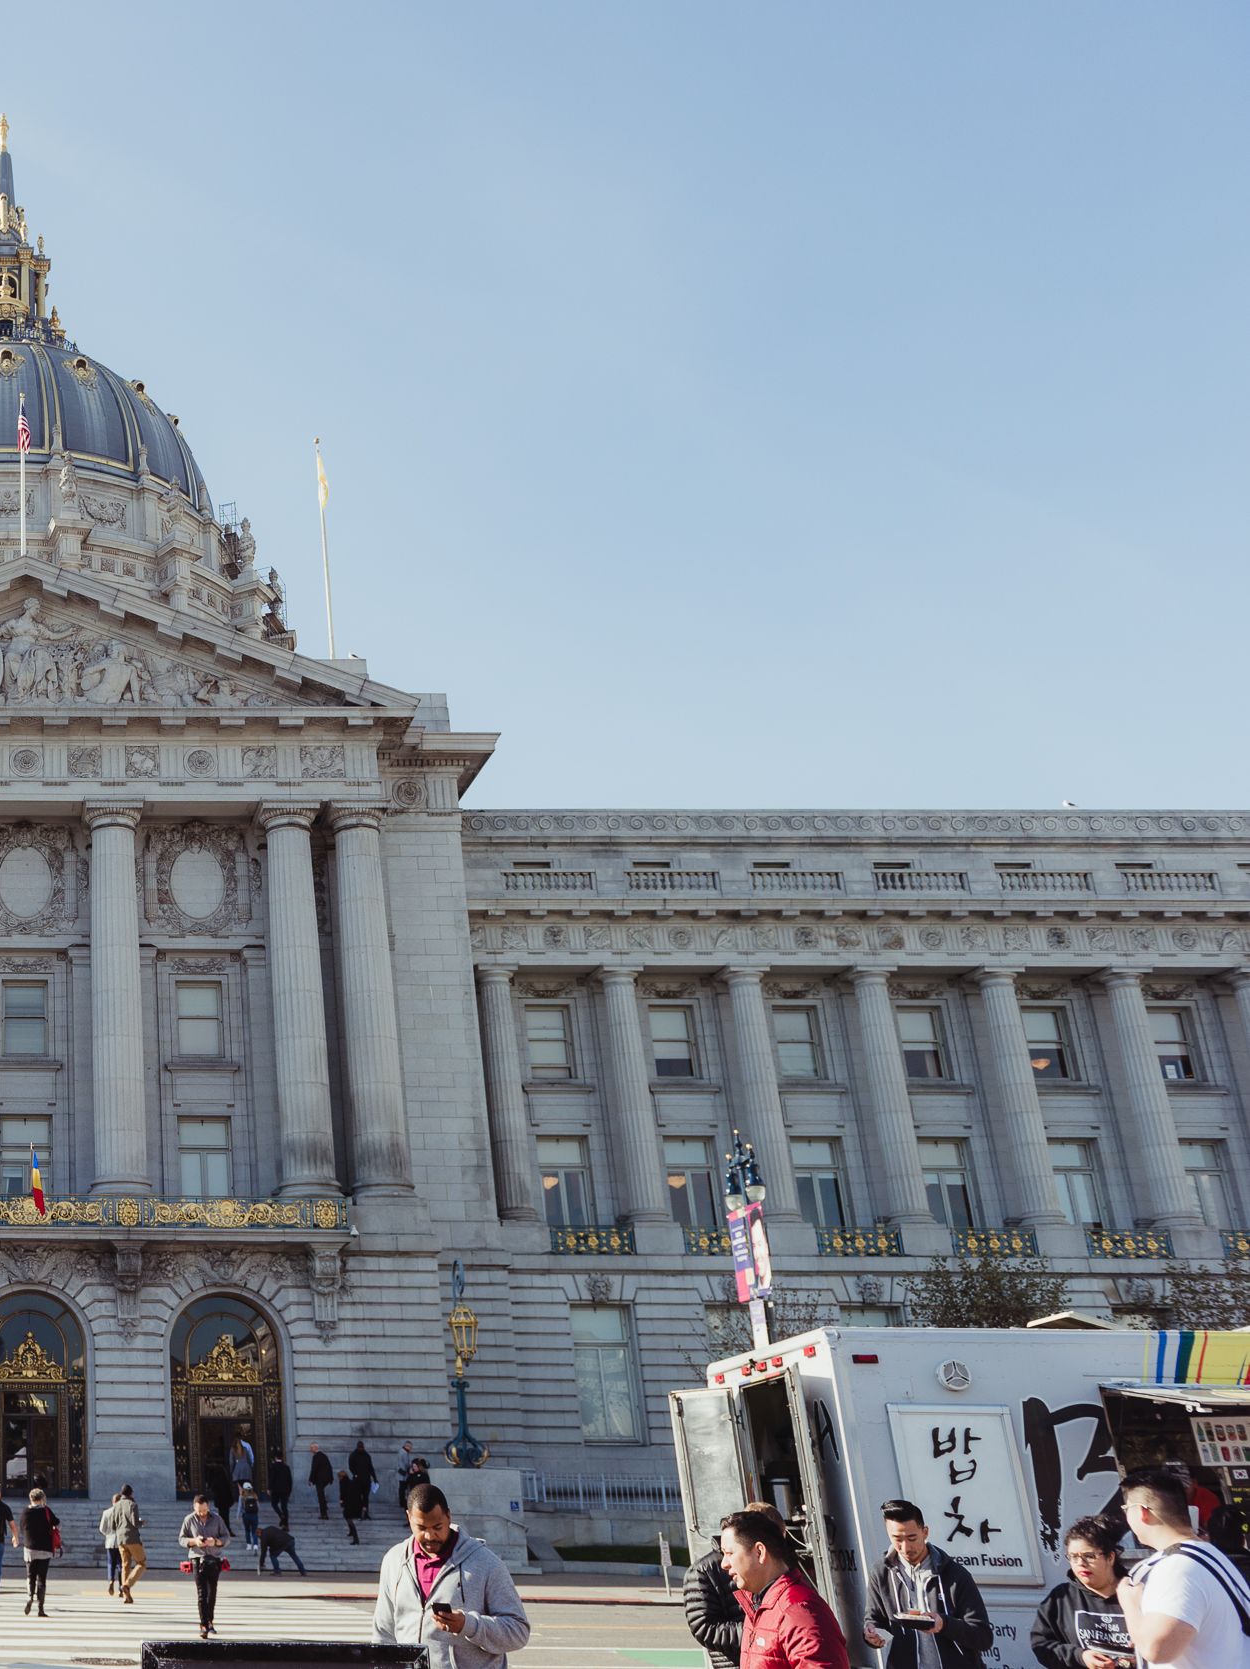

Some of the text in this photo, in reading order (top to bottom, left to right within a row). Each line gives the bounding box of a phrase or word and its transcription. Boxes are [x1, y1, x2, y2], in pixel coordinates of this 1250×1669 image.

[10, 1399, 50, 1408] CTY HALL
[950, 1554, 1023, 1567] rean Fusion
[1095, 1630, 1132, 1644] FRANCISC
